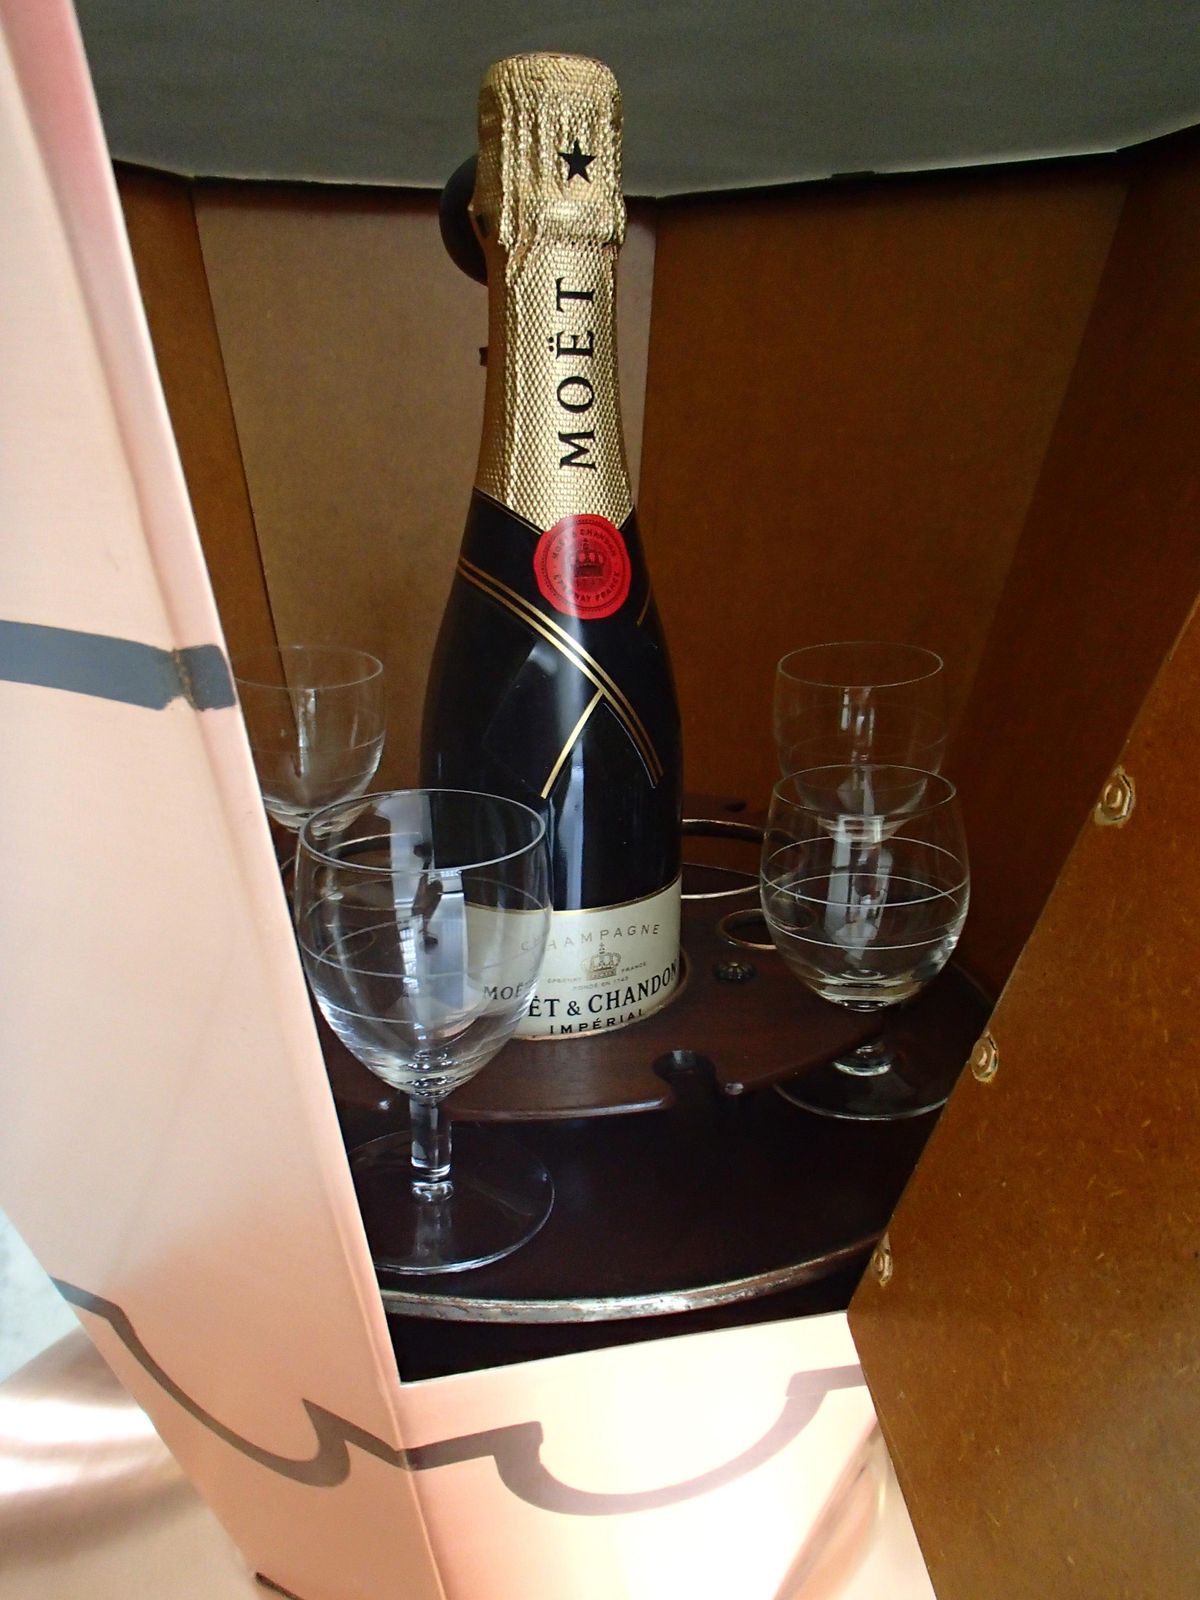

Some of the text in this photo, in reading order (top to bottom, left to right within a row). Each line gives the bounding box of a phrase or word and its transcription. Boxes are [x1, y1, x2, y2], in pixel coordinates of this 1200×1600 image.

[548, 276, 598, 471] MOËT
[520, 924, 660, 951] CHAMPAGNE
[567, 1000, 582, 1016] &
[588, 957, 677, 1014] CHANDON
[550, 1008, 646, 1034] IMPÉRIAL
